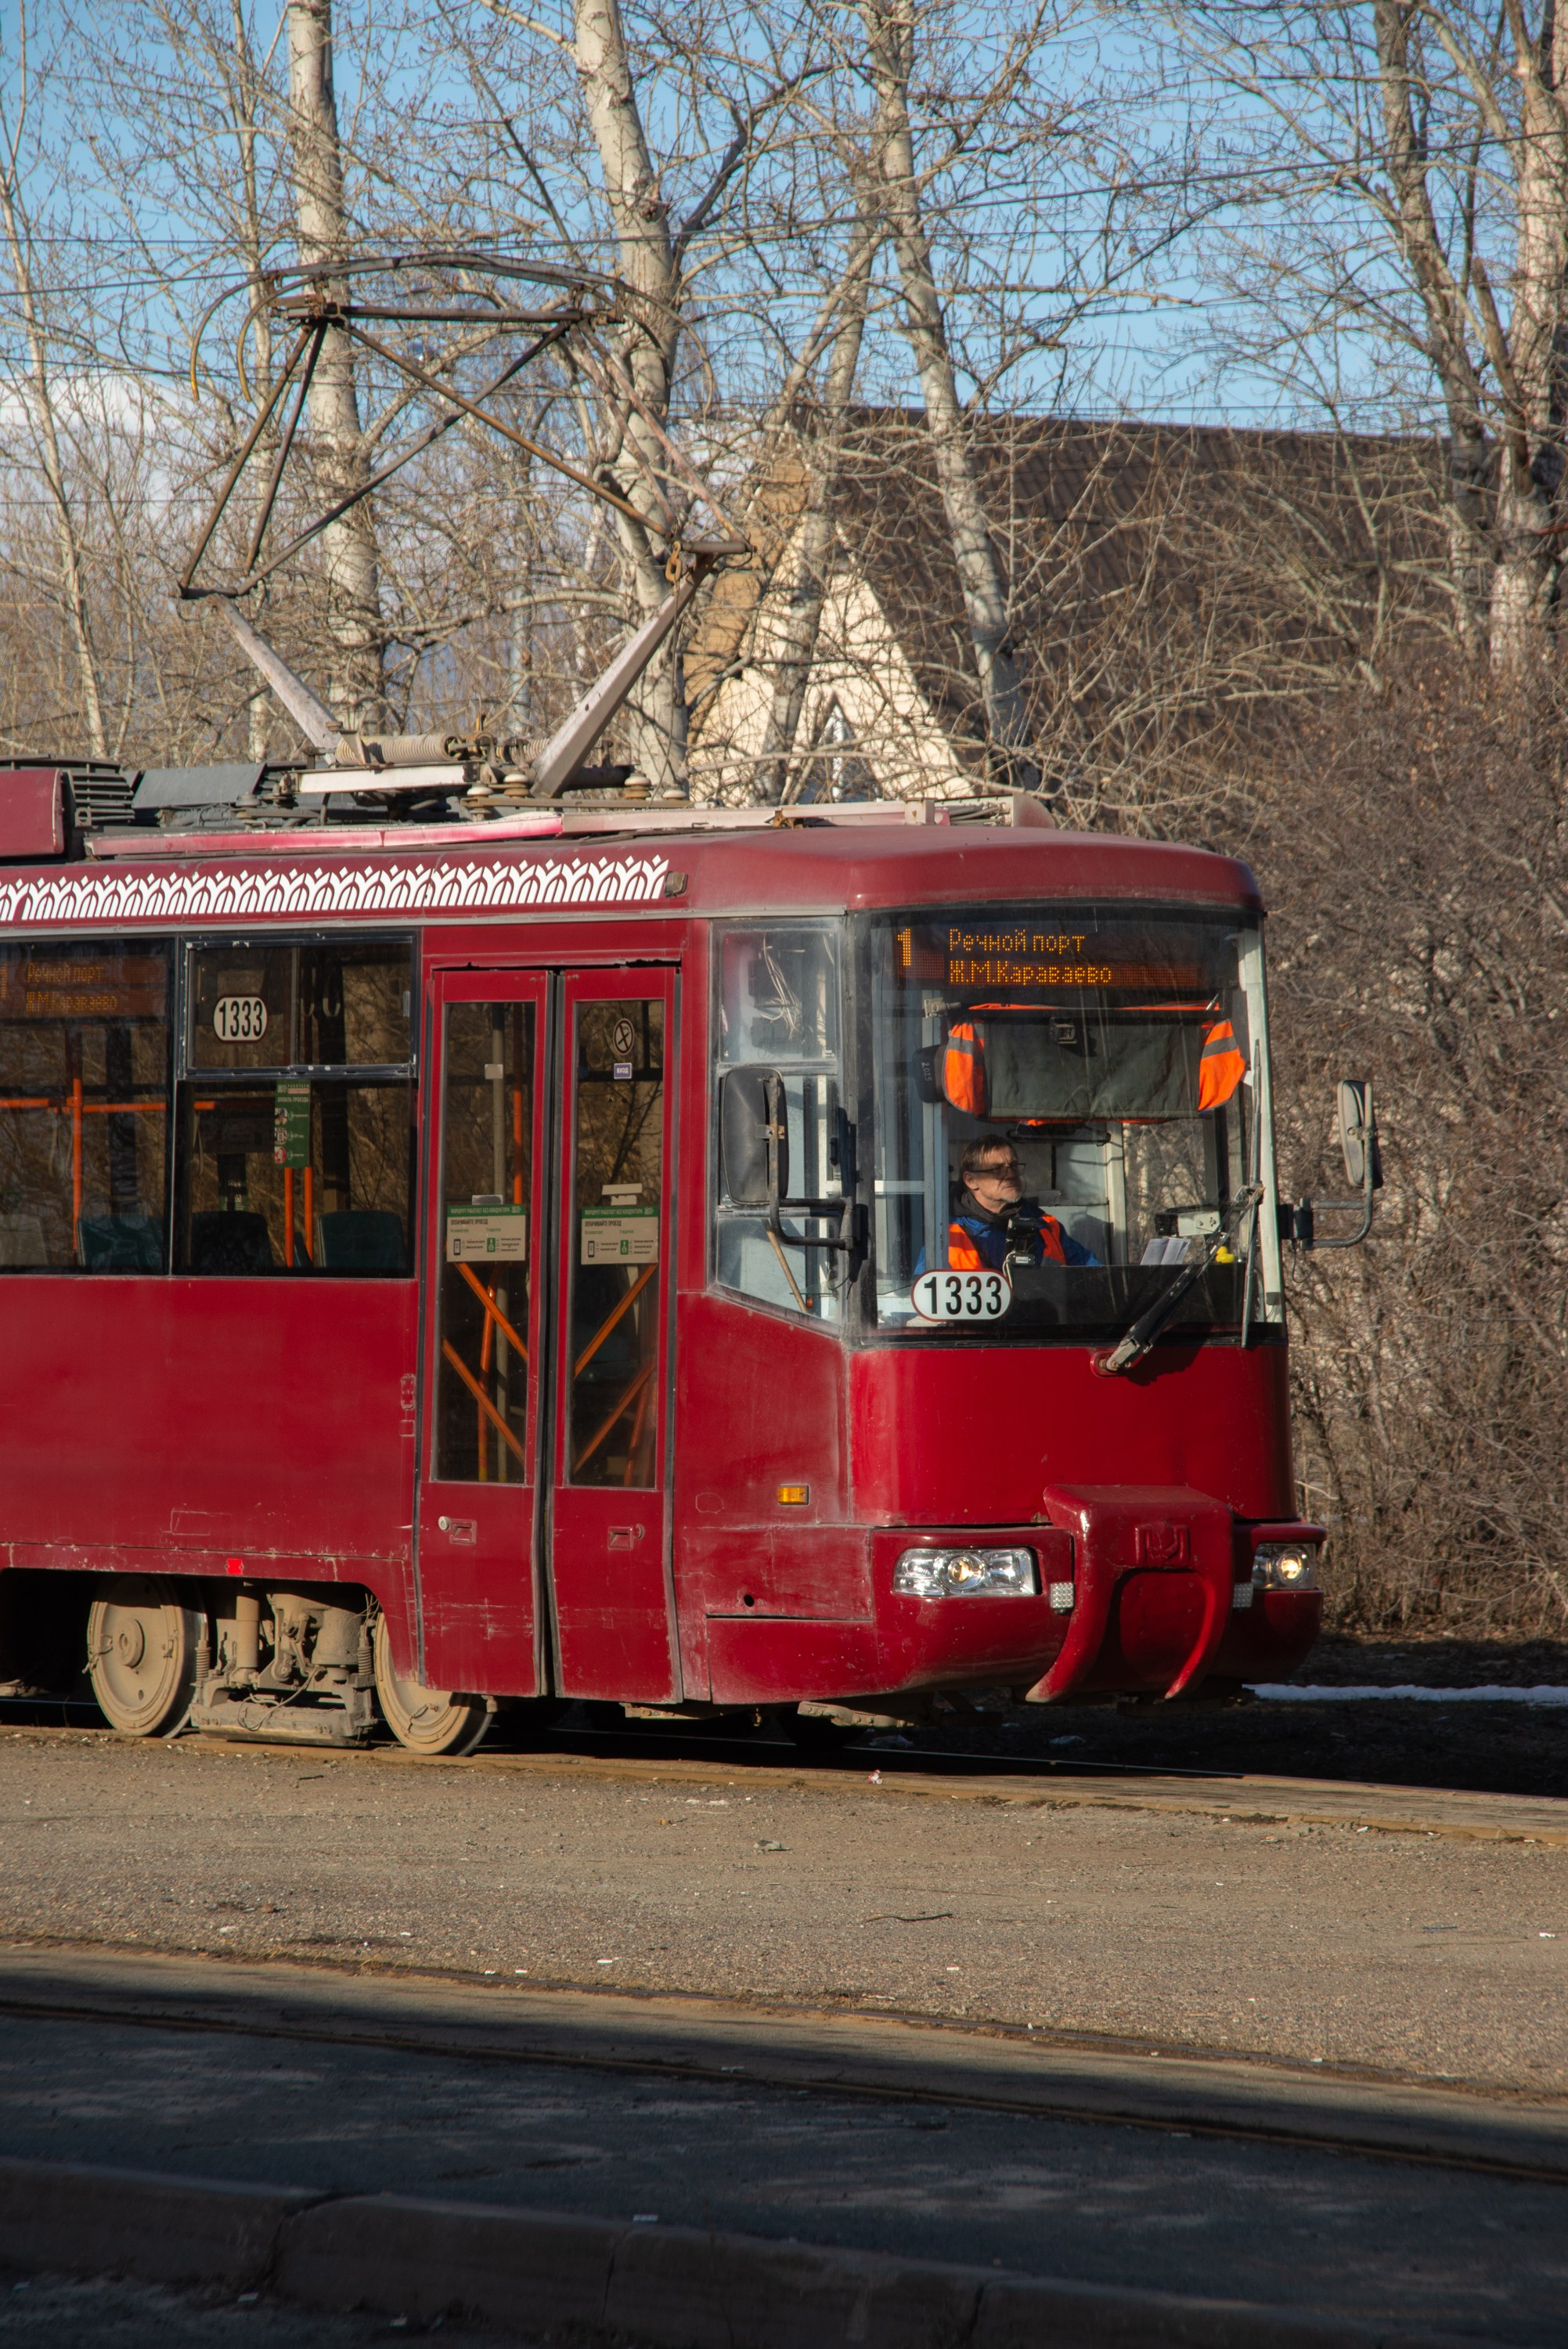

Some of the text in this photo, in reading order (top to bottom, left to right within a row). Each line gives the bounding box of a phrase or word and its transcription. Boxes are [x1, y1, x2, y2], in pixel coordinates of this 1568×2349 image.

[897, 928, 911, 966] 1
[950, 928, 1085, 954] Речной порт
[950, 960, 1112, 986] Ж.М.Караваево
[218, 1000, 262, 1037] 1333
[924, 1276, 1001, 1315] 1333
